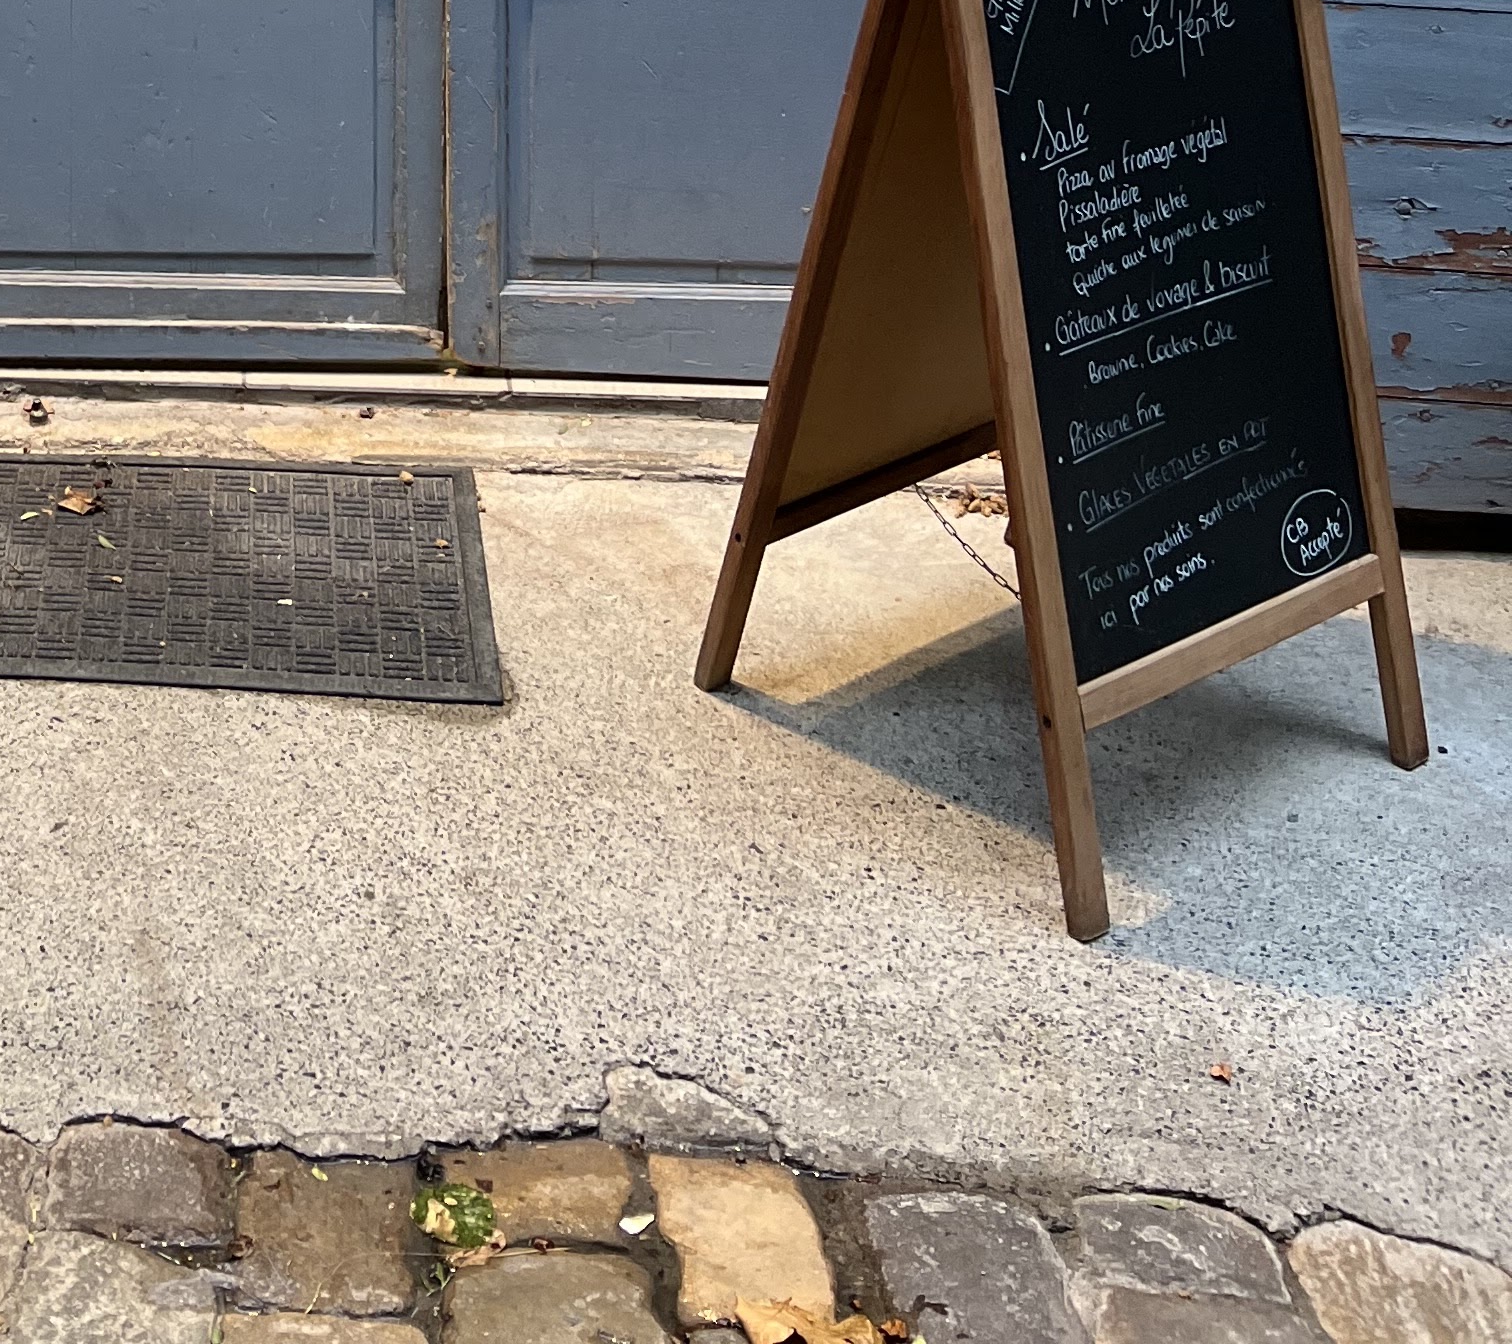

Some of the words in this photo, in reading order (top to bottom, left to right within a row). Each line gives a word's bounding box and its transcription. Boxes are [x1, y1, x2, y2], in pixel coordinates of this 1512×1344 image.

[1031, 99, 1090, 161] Salé
[1057, 167, 1094, 197] Pizza
[1121, 245, 1148, 270] aux
[1201, 209, 1221, 232] de
[1121, 294, 1141, 323] de
[1203, 259, 1215, 294] &
[1218, 244, 1272, 289] biscuit
[1218, 435, 1239, 456] EN
[1143, 516, 1194, 579] produits
[1198, 499, 1225, 531] sont
[1286, 517, 1310, 544] CB
[1129, 584, 1150, 626] par
[1153, 574, 1175, 597] nos
